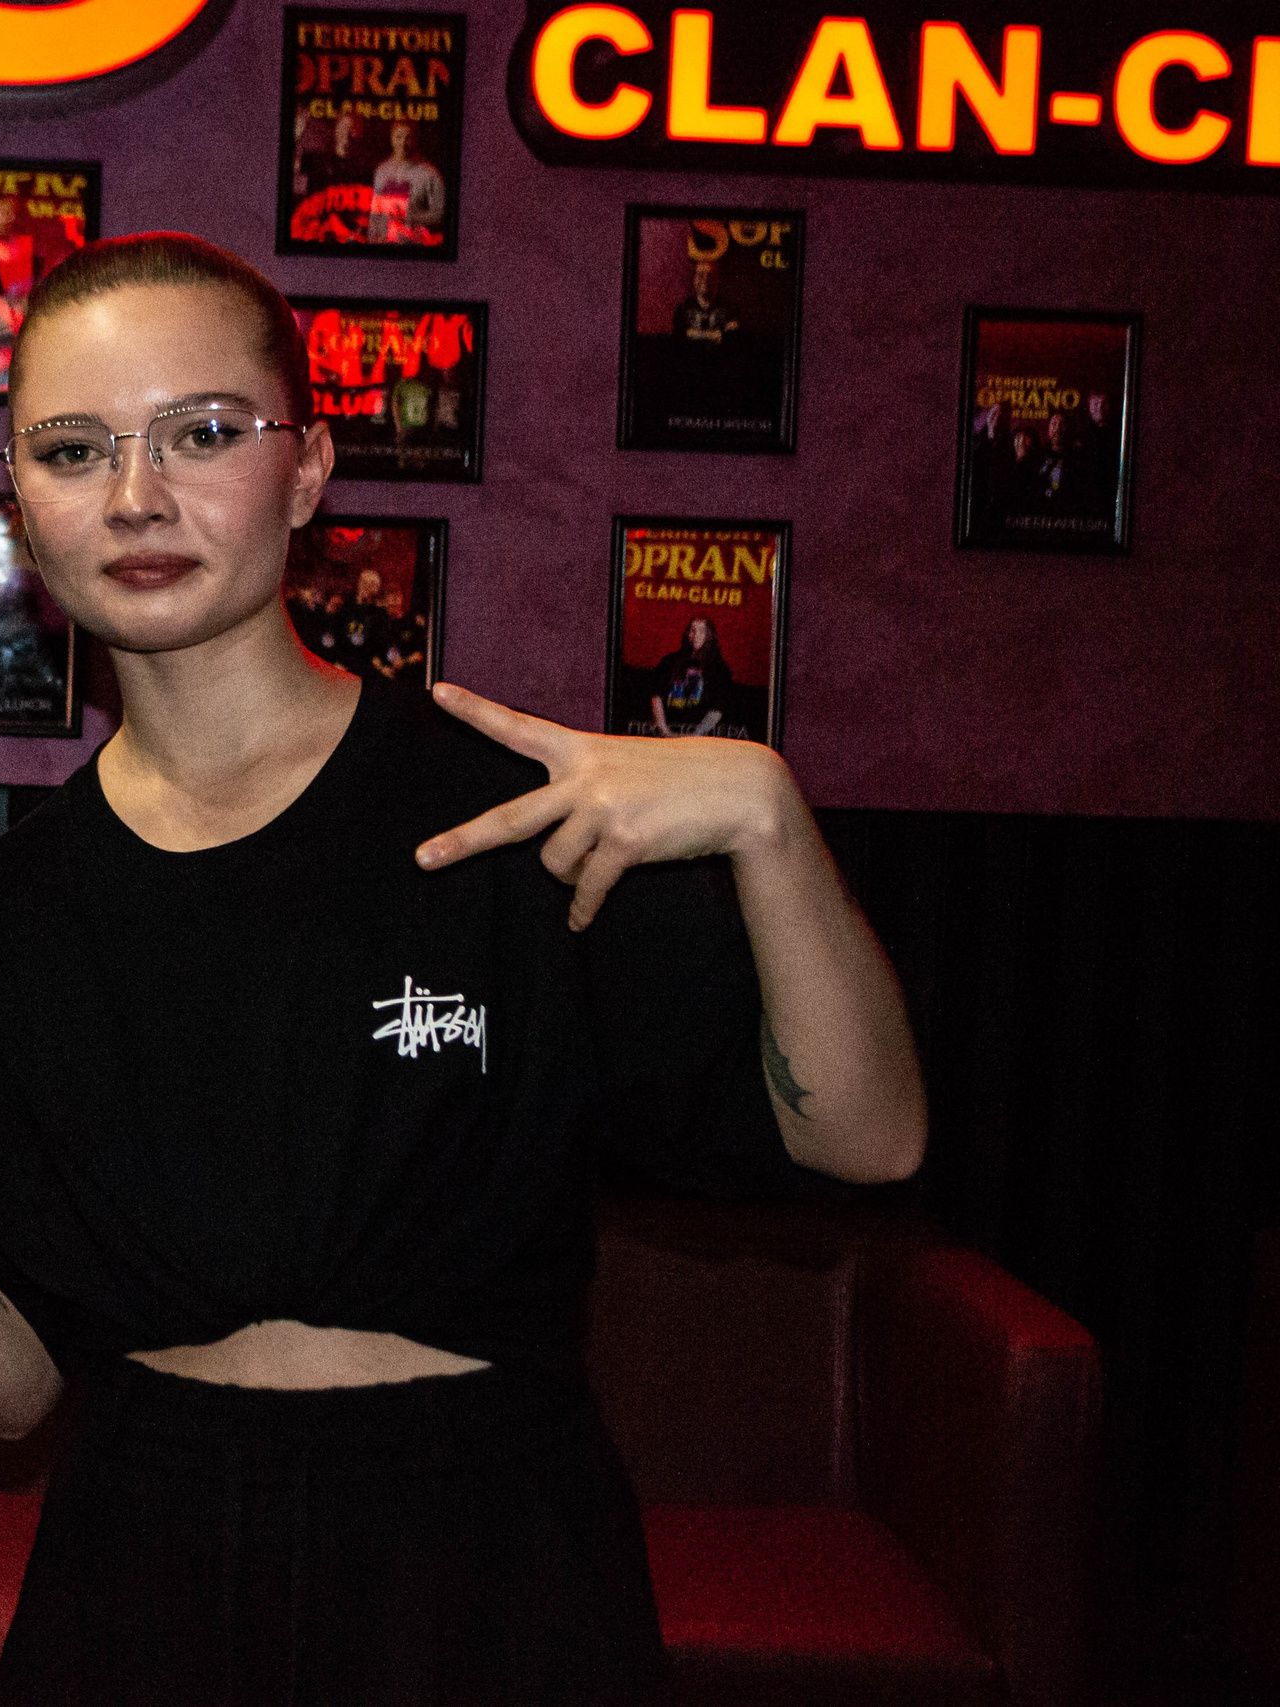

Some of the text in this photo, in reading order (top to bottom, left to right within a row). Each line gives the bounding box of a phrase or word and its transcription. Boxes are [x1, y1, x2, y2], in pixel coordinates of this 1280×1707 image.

[310, 99, 439, 120] CLAN-CLUB
[626, 541, 777, 585] PRAN
[635, 581, 742, 607] CLAN-CLUB
